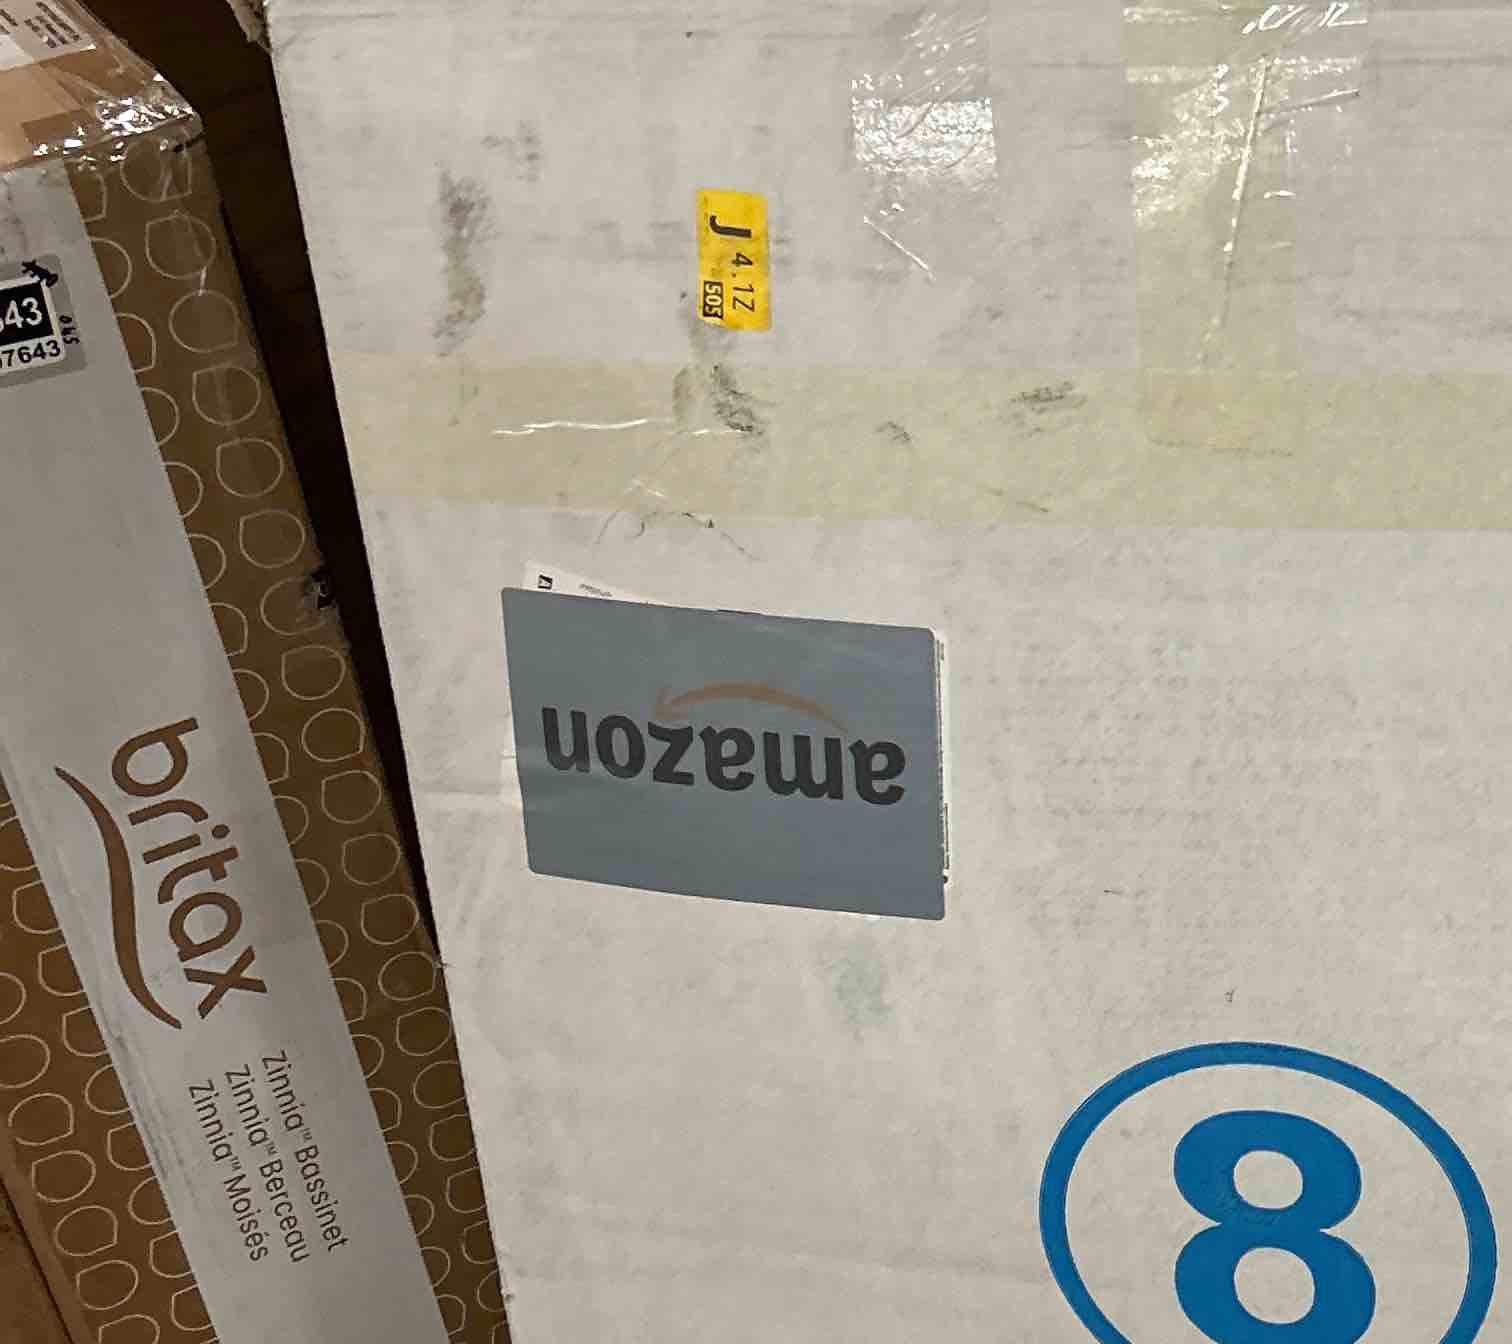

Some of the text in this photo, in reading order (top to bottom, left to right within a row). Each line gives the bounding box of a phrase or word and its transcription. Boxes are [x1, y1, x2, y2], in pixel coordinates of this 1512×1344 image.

[709, 215, 752, 239] J
[0, 296, 42, 332] 43
[0, 340, 60, 367] 7643
[541, 706, 907, 806] amazon
[111, 717, 270, 1021] britax
[223, 1173, 270, 1262] Moisés
[259, 1158, 311, 1264] Berceau
[294, 1144, 350, 1253] Bassinet
